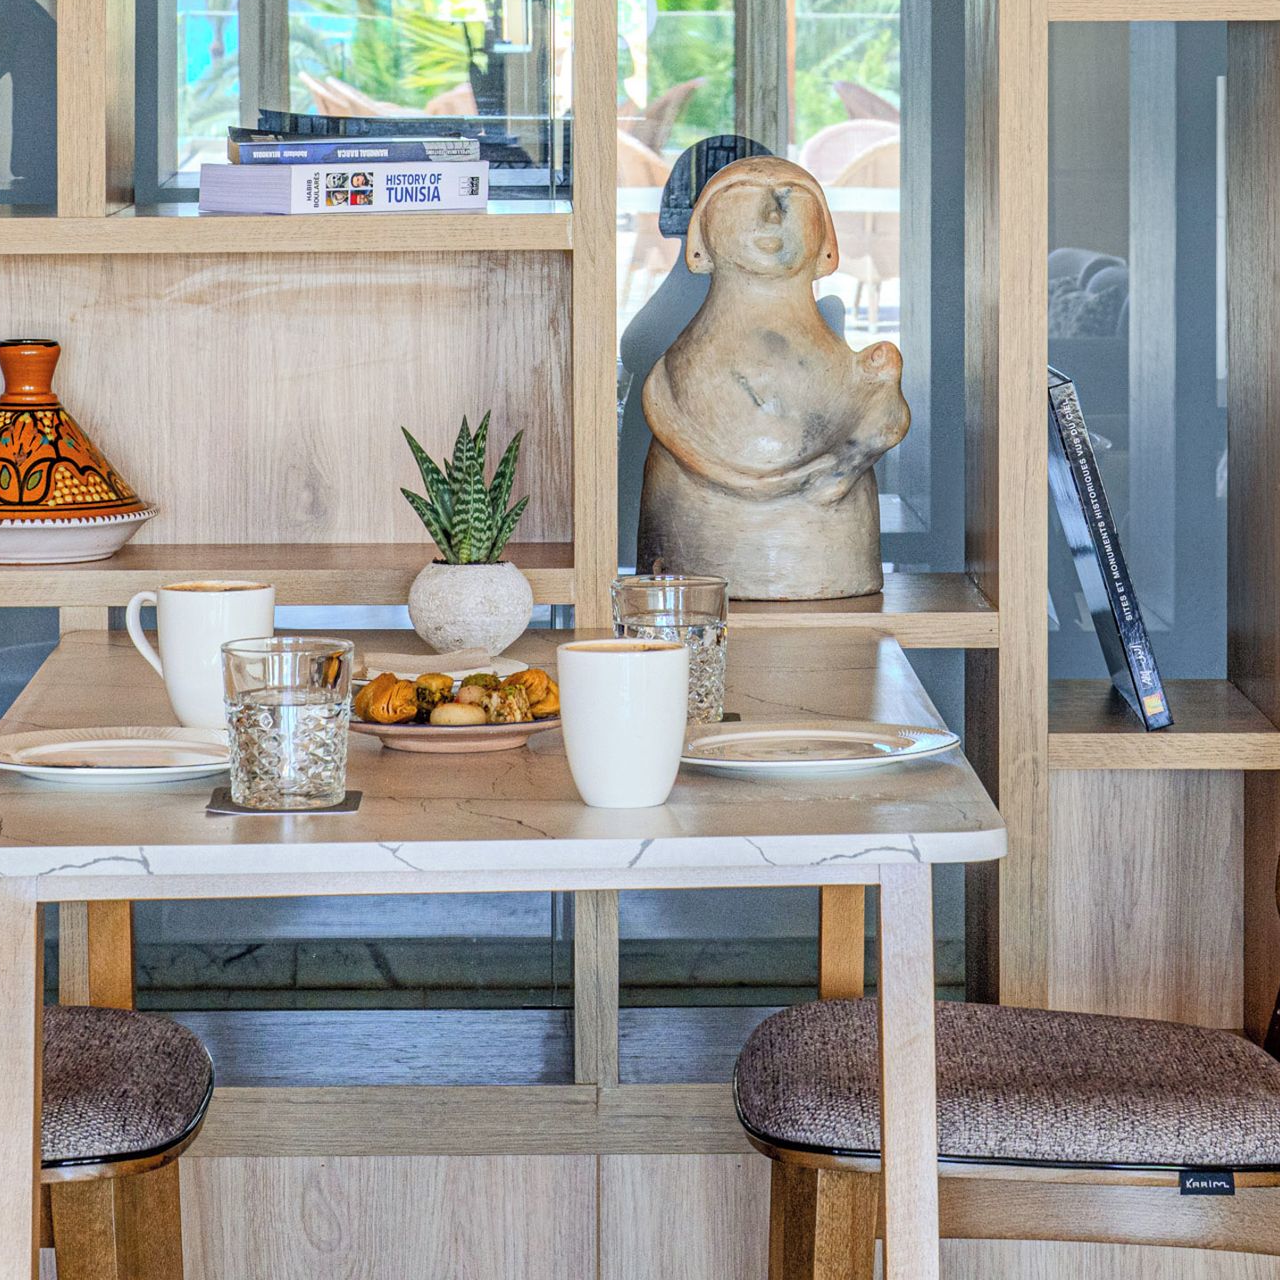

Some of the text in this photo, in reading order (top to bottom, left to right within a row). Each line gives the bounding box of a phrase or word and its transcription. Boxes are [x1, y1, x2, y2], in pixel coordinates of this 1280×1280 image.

[386, 173, 442, 186] HISTORY OF
[386, 186, 441, 203] TUNISIA
[1063, 399, 1133, 621] SITES ET MONUMENTS HISTORIQUES VUS DU CIEL
